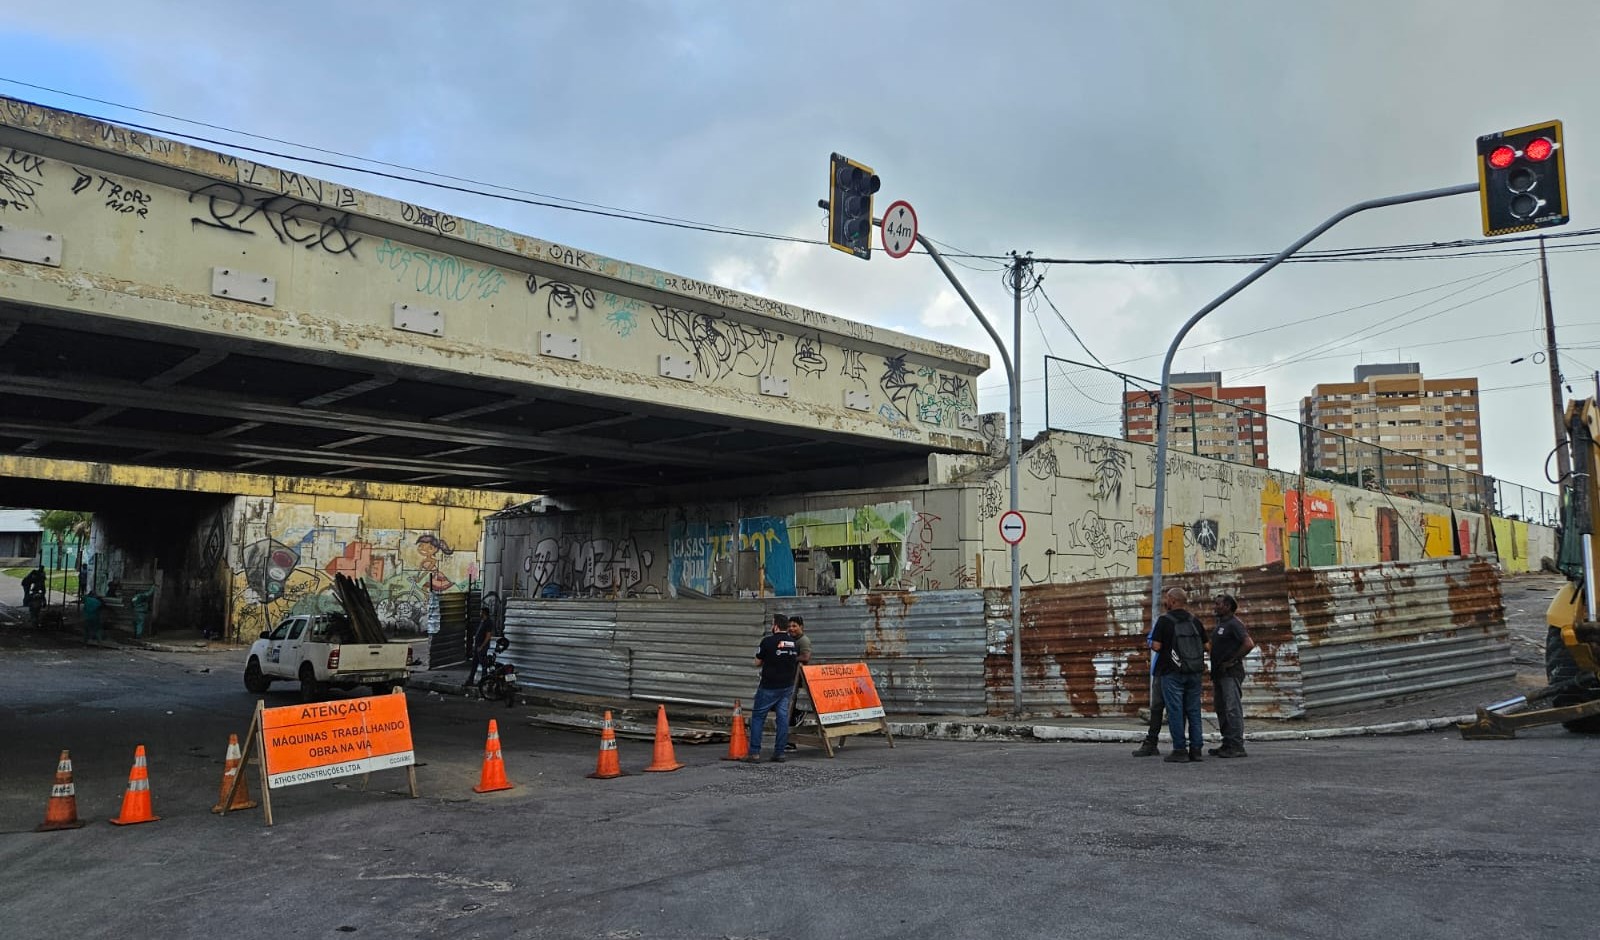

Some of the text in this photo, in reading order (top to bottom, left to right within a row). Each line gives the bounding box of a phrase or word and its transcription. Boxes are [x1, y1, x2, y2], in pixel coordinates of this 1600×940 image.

[887, 221, 912, 238] 4,4m
[332, 720, 405, 739] TRABALHANDO
[309, 740, 373, 758] OBRA NA VIA
[274, 763, 361, 786] ATHOS CONSTRUÇÕES LTDA
